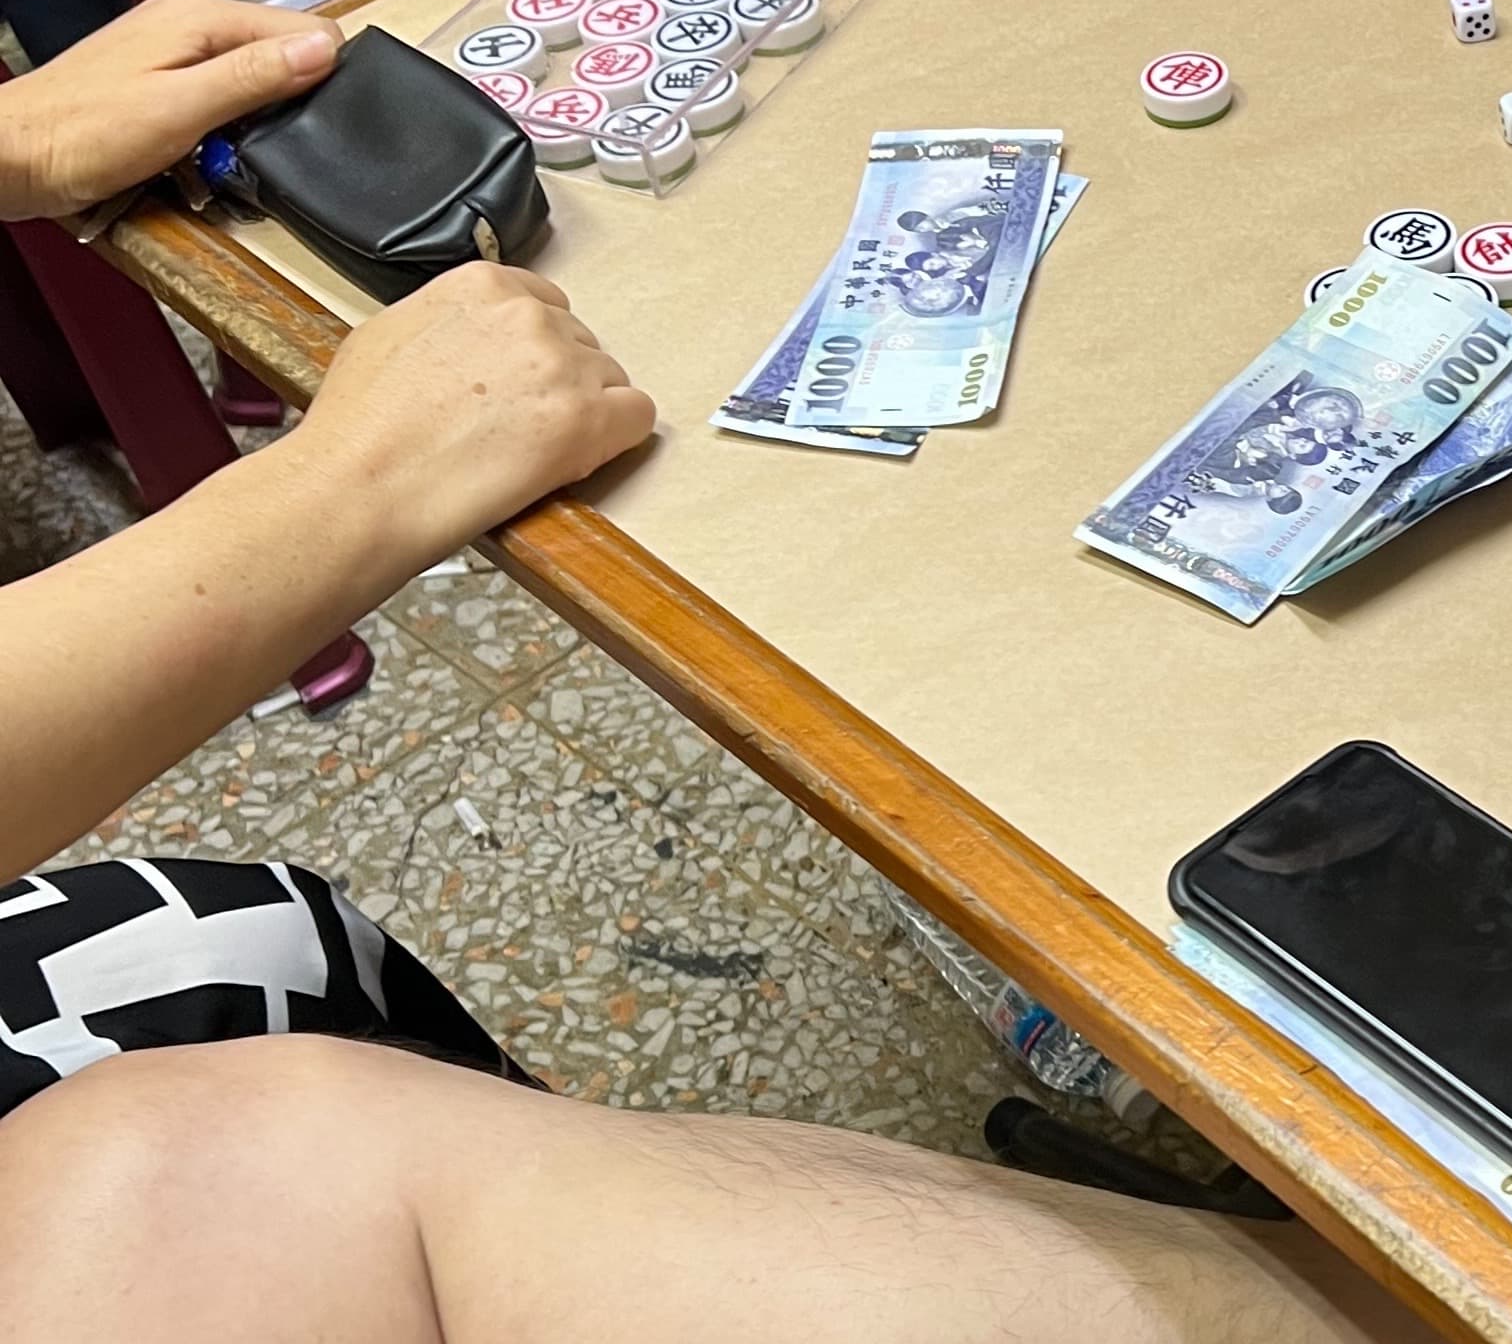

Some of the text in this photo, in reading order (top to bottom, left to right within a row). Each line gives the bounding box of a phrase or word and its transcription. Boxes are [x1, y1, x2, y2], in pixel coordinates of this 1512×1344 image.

[1380, 217, 1438, 256] 馬
[840, 239, 881, 309] 中華民國
[1329, 270, 1388, 327] 1000
[803, 335, 862, 414] 1000
[957, 352, 990, 409] 1000
[1423, 318, 1512, 406] 1000
[1332, 430, 1417, 496] 中華民國
